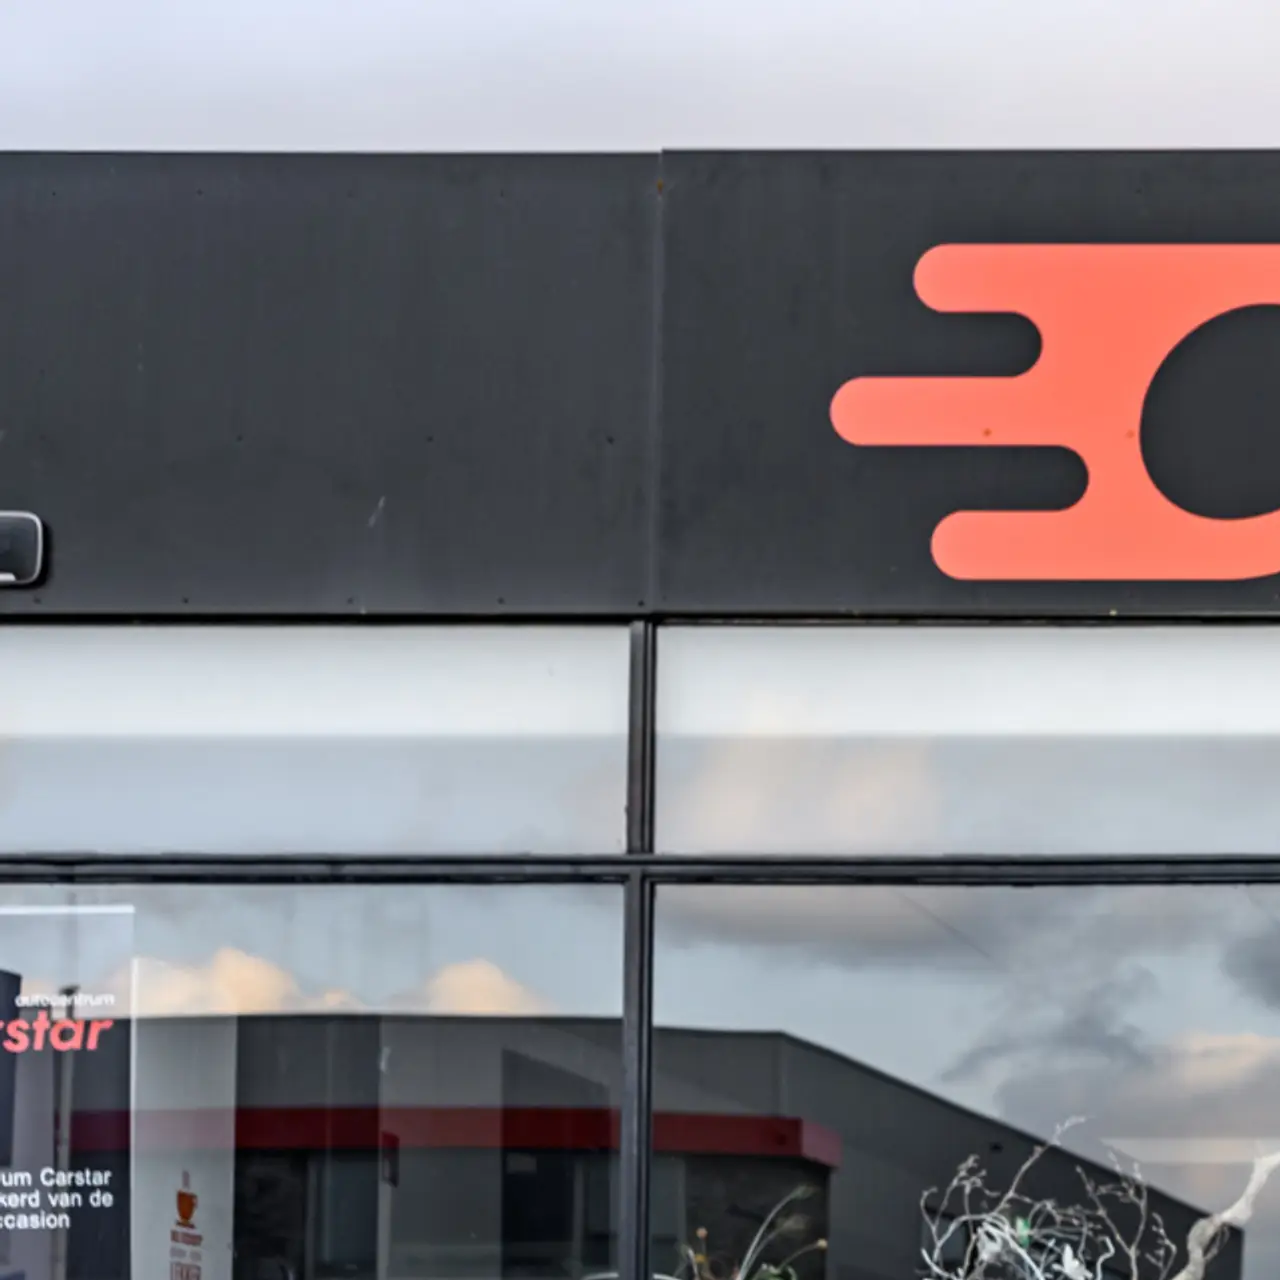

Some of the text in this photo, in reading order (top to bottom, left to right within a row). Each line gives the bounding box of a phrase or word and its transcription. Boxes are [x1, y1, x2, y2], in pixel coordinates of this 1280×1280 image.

[0, 1010, 114, 1053] star
[0, 1166, 112, 1187] um Carstar
[47, 1191, 82, 1208] van
[89, 1188, 114, 1208] de
